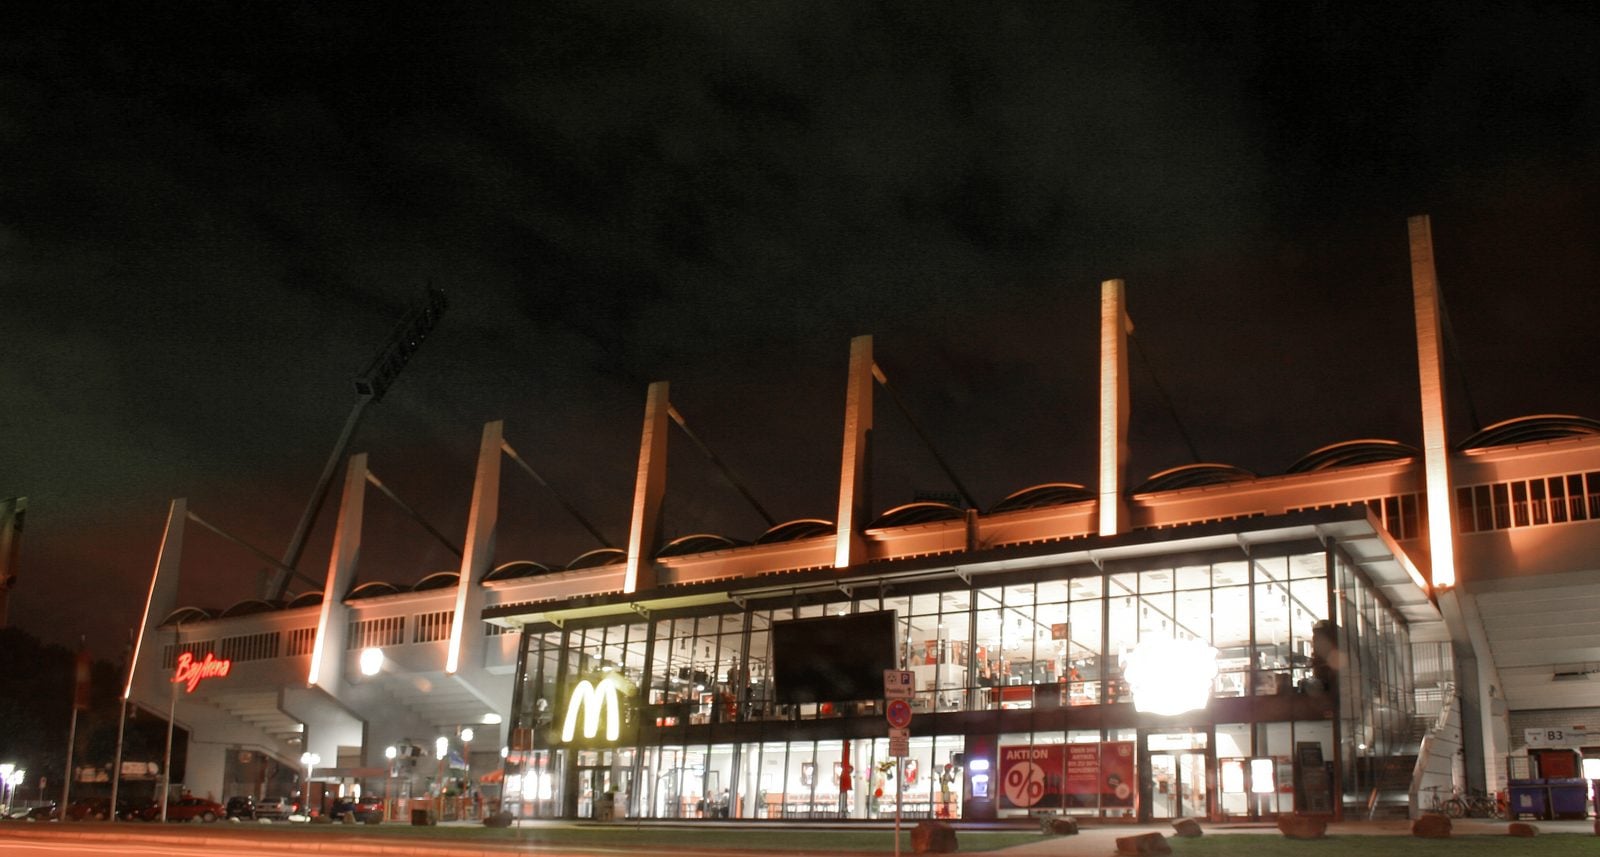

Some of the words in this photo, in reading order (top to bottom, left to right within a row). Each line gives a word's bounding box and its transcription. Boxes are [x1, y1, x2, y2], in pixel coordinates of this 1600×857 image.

[562, 679, 619, 742] M
[1547, 730, 1563, 741] B3
[1006, 749, 1049, 760] AKTION
